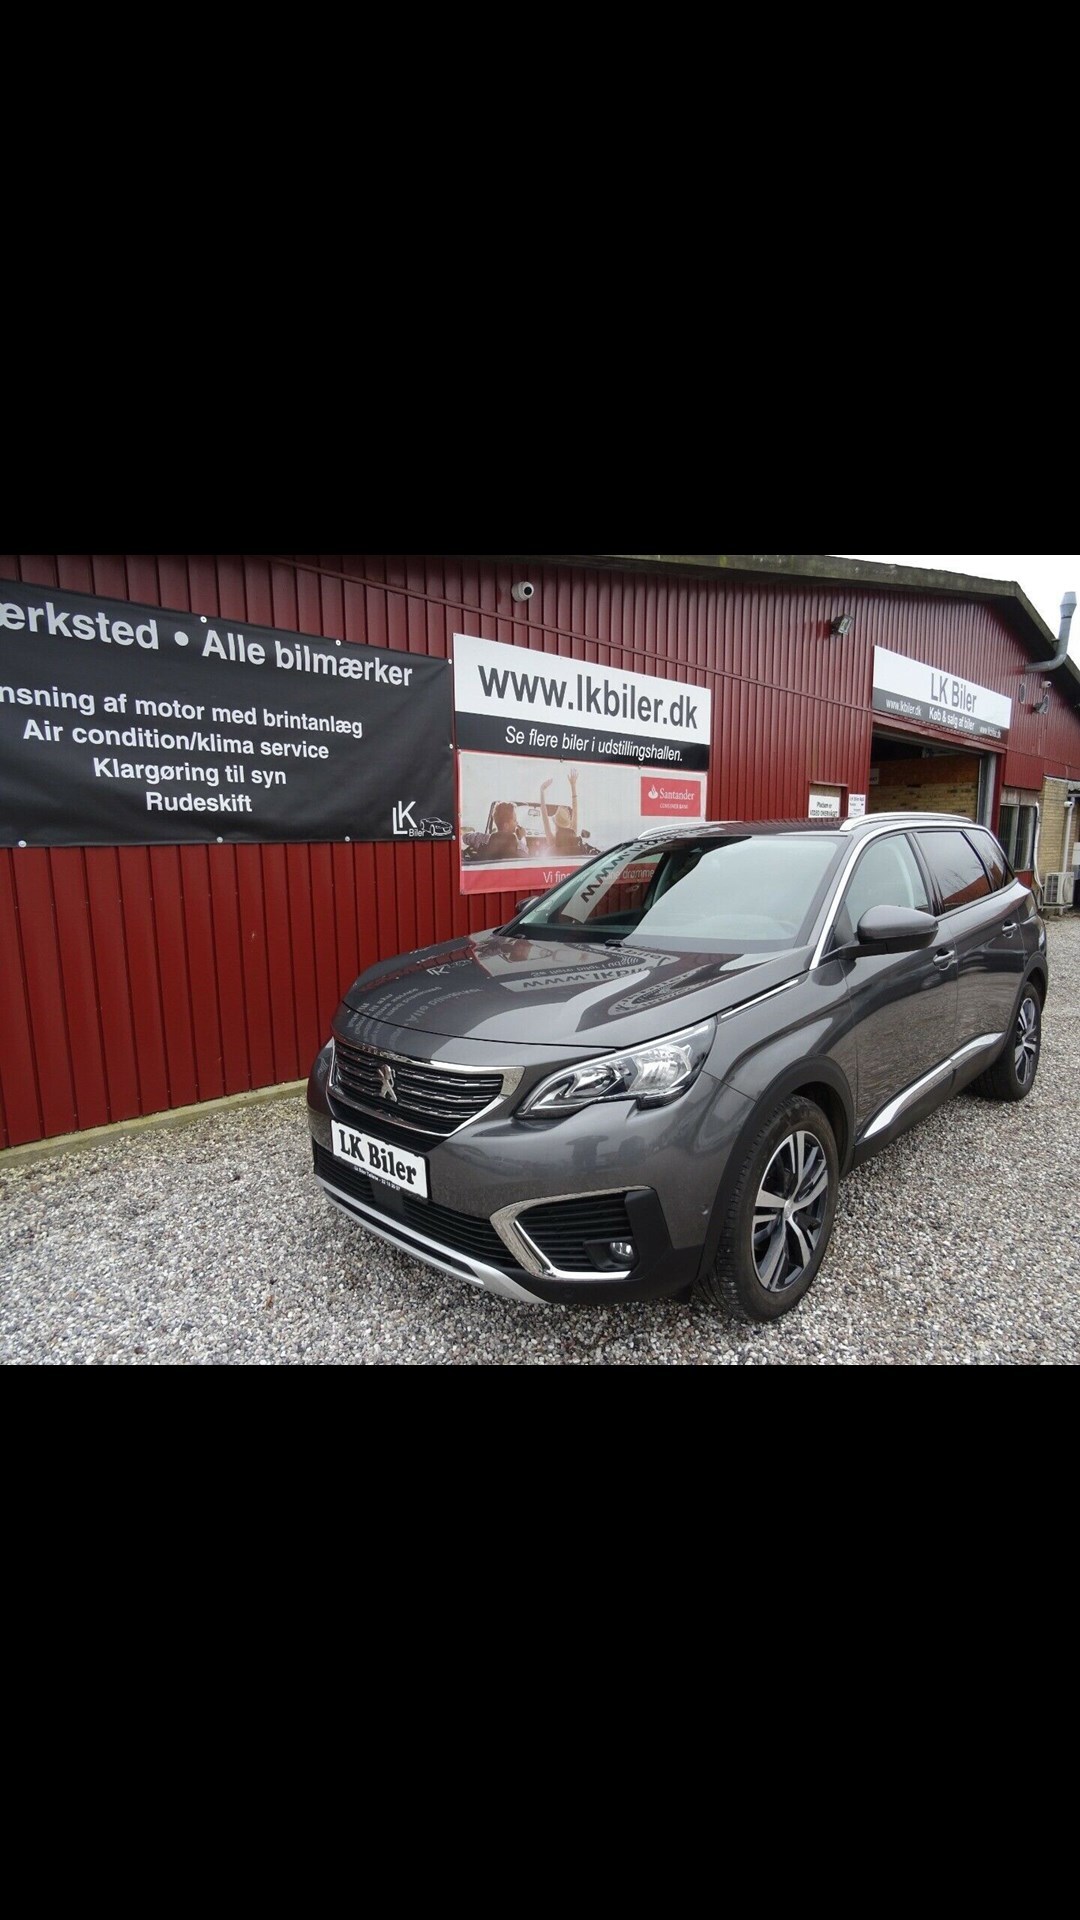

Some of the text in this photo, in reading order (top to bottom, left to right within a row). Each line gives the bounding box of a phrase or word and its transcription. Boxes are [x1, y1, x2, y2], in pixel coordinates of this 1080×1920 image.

[202, 629, 266, 666] Alle
[274, 640, 413, 687] bilmærker
[477, 664, 698, 730] www.lkbiler.dk
[931, 672, 977, 714] LK Biler
[0, 685, 363, 739] nsning af motor med brintanlæg
[885, 699, 922, 717] www.lkbiler.dk
[929, 706, 942, 721] Køb
[947, 713, 958, 729] salg
[958, 716, 964, 726] af
[964, 717, 975, 731] biler
[23, 719, 330, 759] Air condition/klima service
[505, 725, 684, 762] Se flere biler i udstillingshallen.
[93, 757, 287, 789] Klargøring til syn
[146, 791, 252, 813] Rudeskift
[659, 787, 695, 801] Santander
[392, 800, 418, 835] LK
[408, 828, 426, 837] Biler
[543, 871, 553, 884] Vi
[338, 1129, 365, 1162] LK
[367, 1141, 417, 1185] Biler
